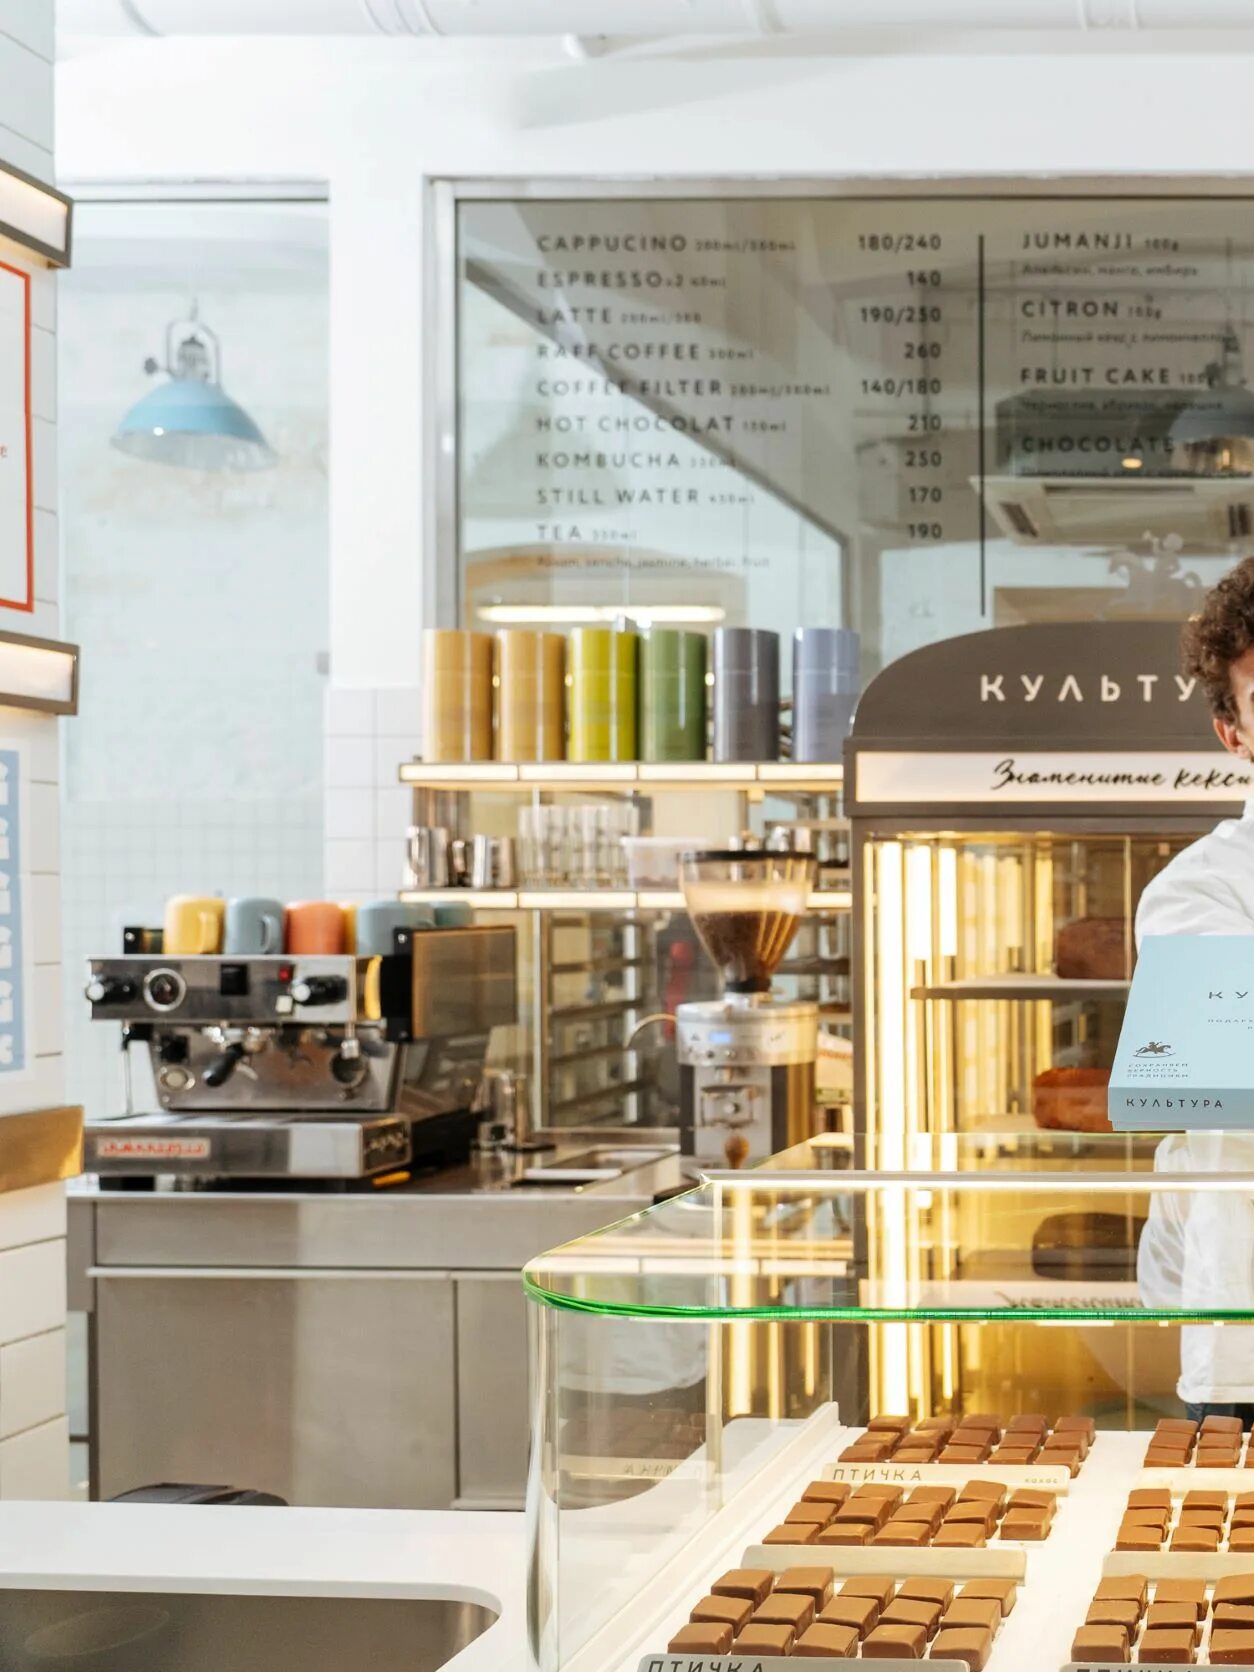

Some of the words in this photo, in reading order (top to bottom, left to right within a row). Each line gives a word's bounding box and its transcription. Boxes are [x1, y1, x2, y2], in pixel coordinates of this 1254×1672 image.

[537, 235, 687, 251] CAPPUCINO
[858, 235, 941, 252] 180/240
[1021, 234, 1133, 250] JUMANJI
[537, 272, 662, 288] ESPRESSO
[907, 271, 941, 287] 140
[537, 308, 613, 325] LATTE
[859, 307, 941, 325] 190/250
[1021, 302, 1119, 318] CITRON
[537, 343, 598, 360] RAFF
[607, 343, 700, 360] COFFEE
[904, 343, 941, 358] 260
[1020, 368, 1094, 384] FRUIT
[1105, 368, 1171, 384] CAKE
[537, 380, 629, 397] COFFEE
[640, 380, 722, 397] FILTER
[861, 379, 941, 396] 140/180
[536, 417, 586, 432] HOT
[598, 416, 736, 432] CHOCOLAT
[908, 416, 941, 431] 210
[1021, 436, 1174, 453] CHOCOLATE
[537, 453, 681, 468] KOMBUCHA
[905, 452, 941, 467] 250
[537, 488, 602, 504] STILL
[616, 488, 699, 504] WATER
[908, 487, 942, 503] 170
[537, 525, 583, 541] TEA
[907, 524, 943, 539] 190
[980, 674, 1197, 702] КУЛЬТУ
[991, 758, 1166, 790] Знаменитые
[1126, 1098, 1223, 1109] КУЛЬТУРА
[832, 1468, 922, 1482] ПТИЧКА
